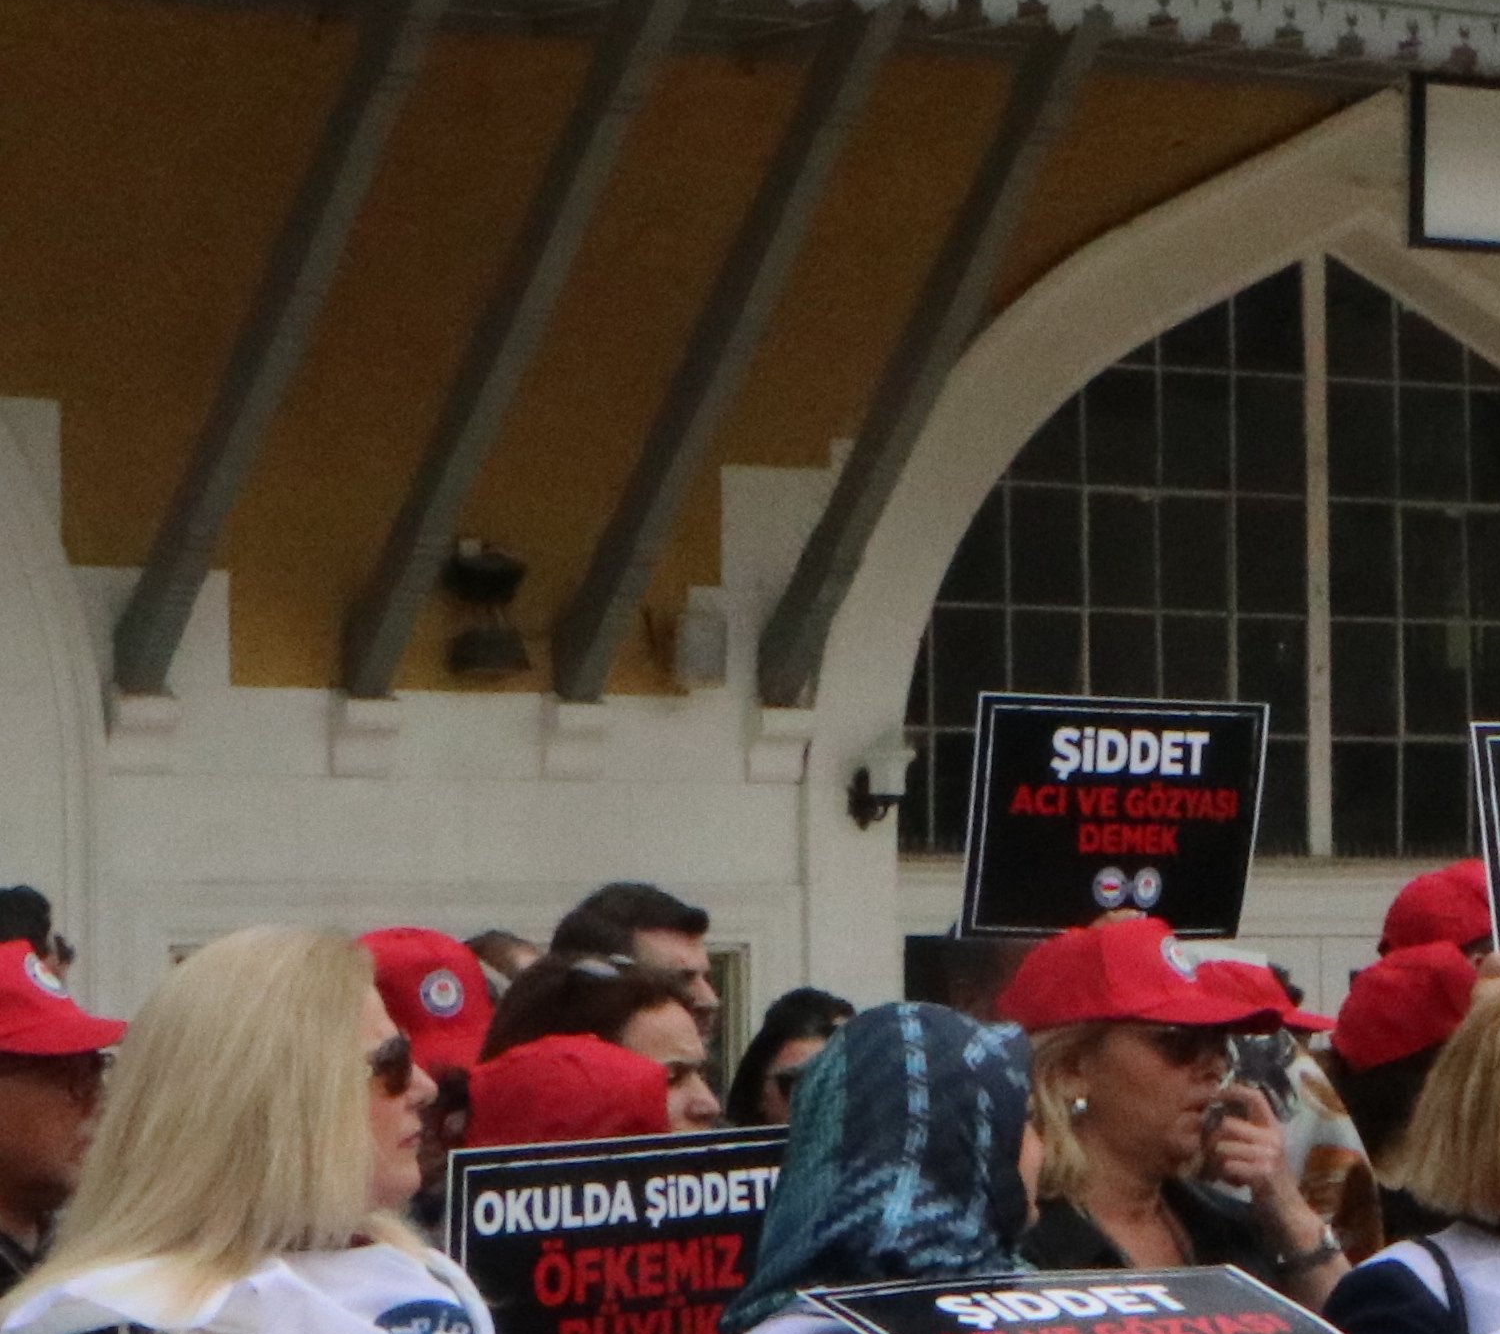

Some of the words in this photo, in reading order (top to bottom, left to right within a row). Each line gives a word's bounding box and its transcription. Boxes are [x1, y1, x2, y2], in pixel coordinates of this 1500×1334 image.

[1050, 725, 1210, 781] ŞİDDET
[1009, 784, 1068, 816] ACI
[1077, 786, 1119, 817] VE
[1077, 823, 1179, 855] DEMEK
[473, 1178, 638, 1237] OKULDA
[533, 1233, 745, 1307] ÖFKEMİZ
[935, 1284, 1185, 1330] ŞİDDET
